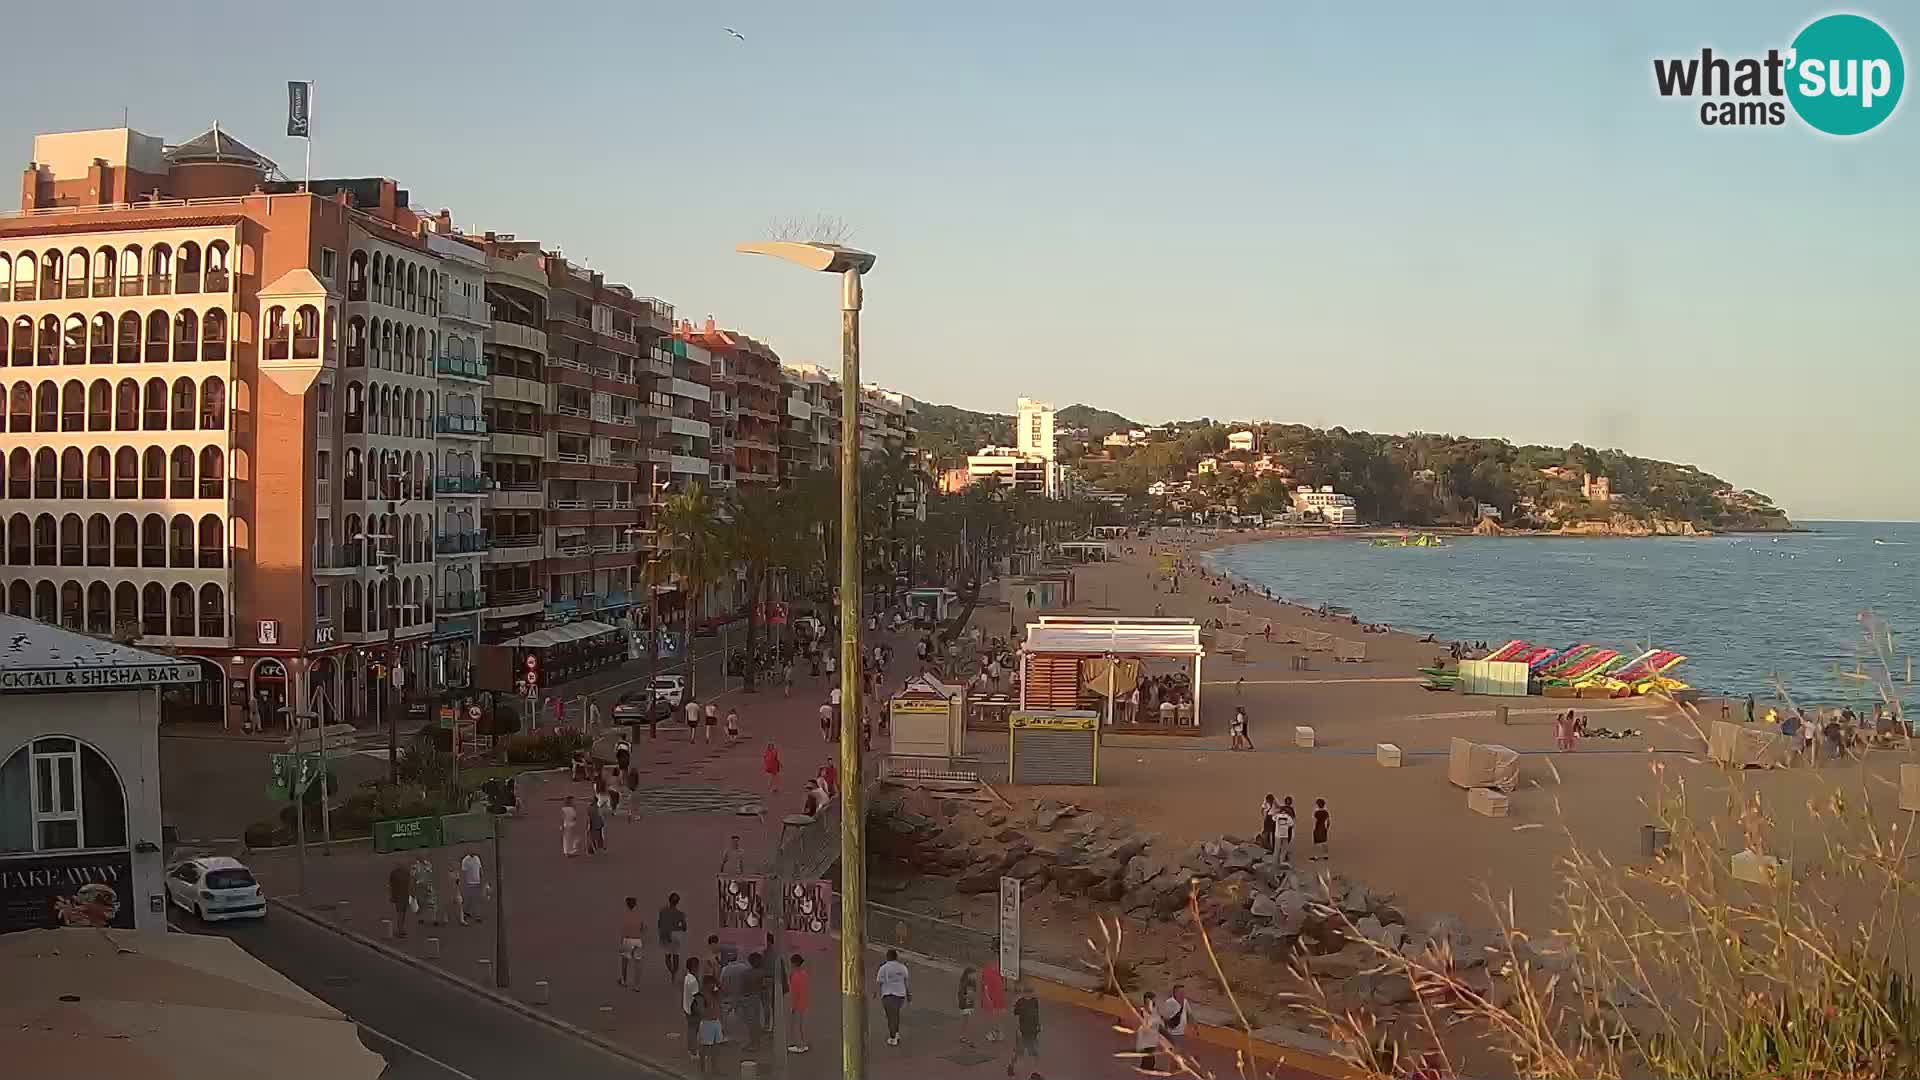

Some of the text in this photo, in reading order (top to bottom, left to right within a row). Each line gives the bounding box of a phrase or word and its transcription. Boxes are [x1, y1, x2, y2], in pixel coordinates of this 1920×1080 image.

[315, 627, 335, 644] KFC
[65, 670, 77, 685] &
[81, 668, 143, 685] SHISHA
[148, 666, 181, 682] BAR
[260, 665, 286, 677] KFC
